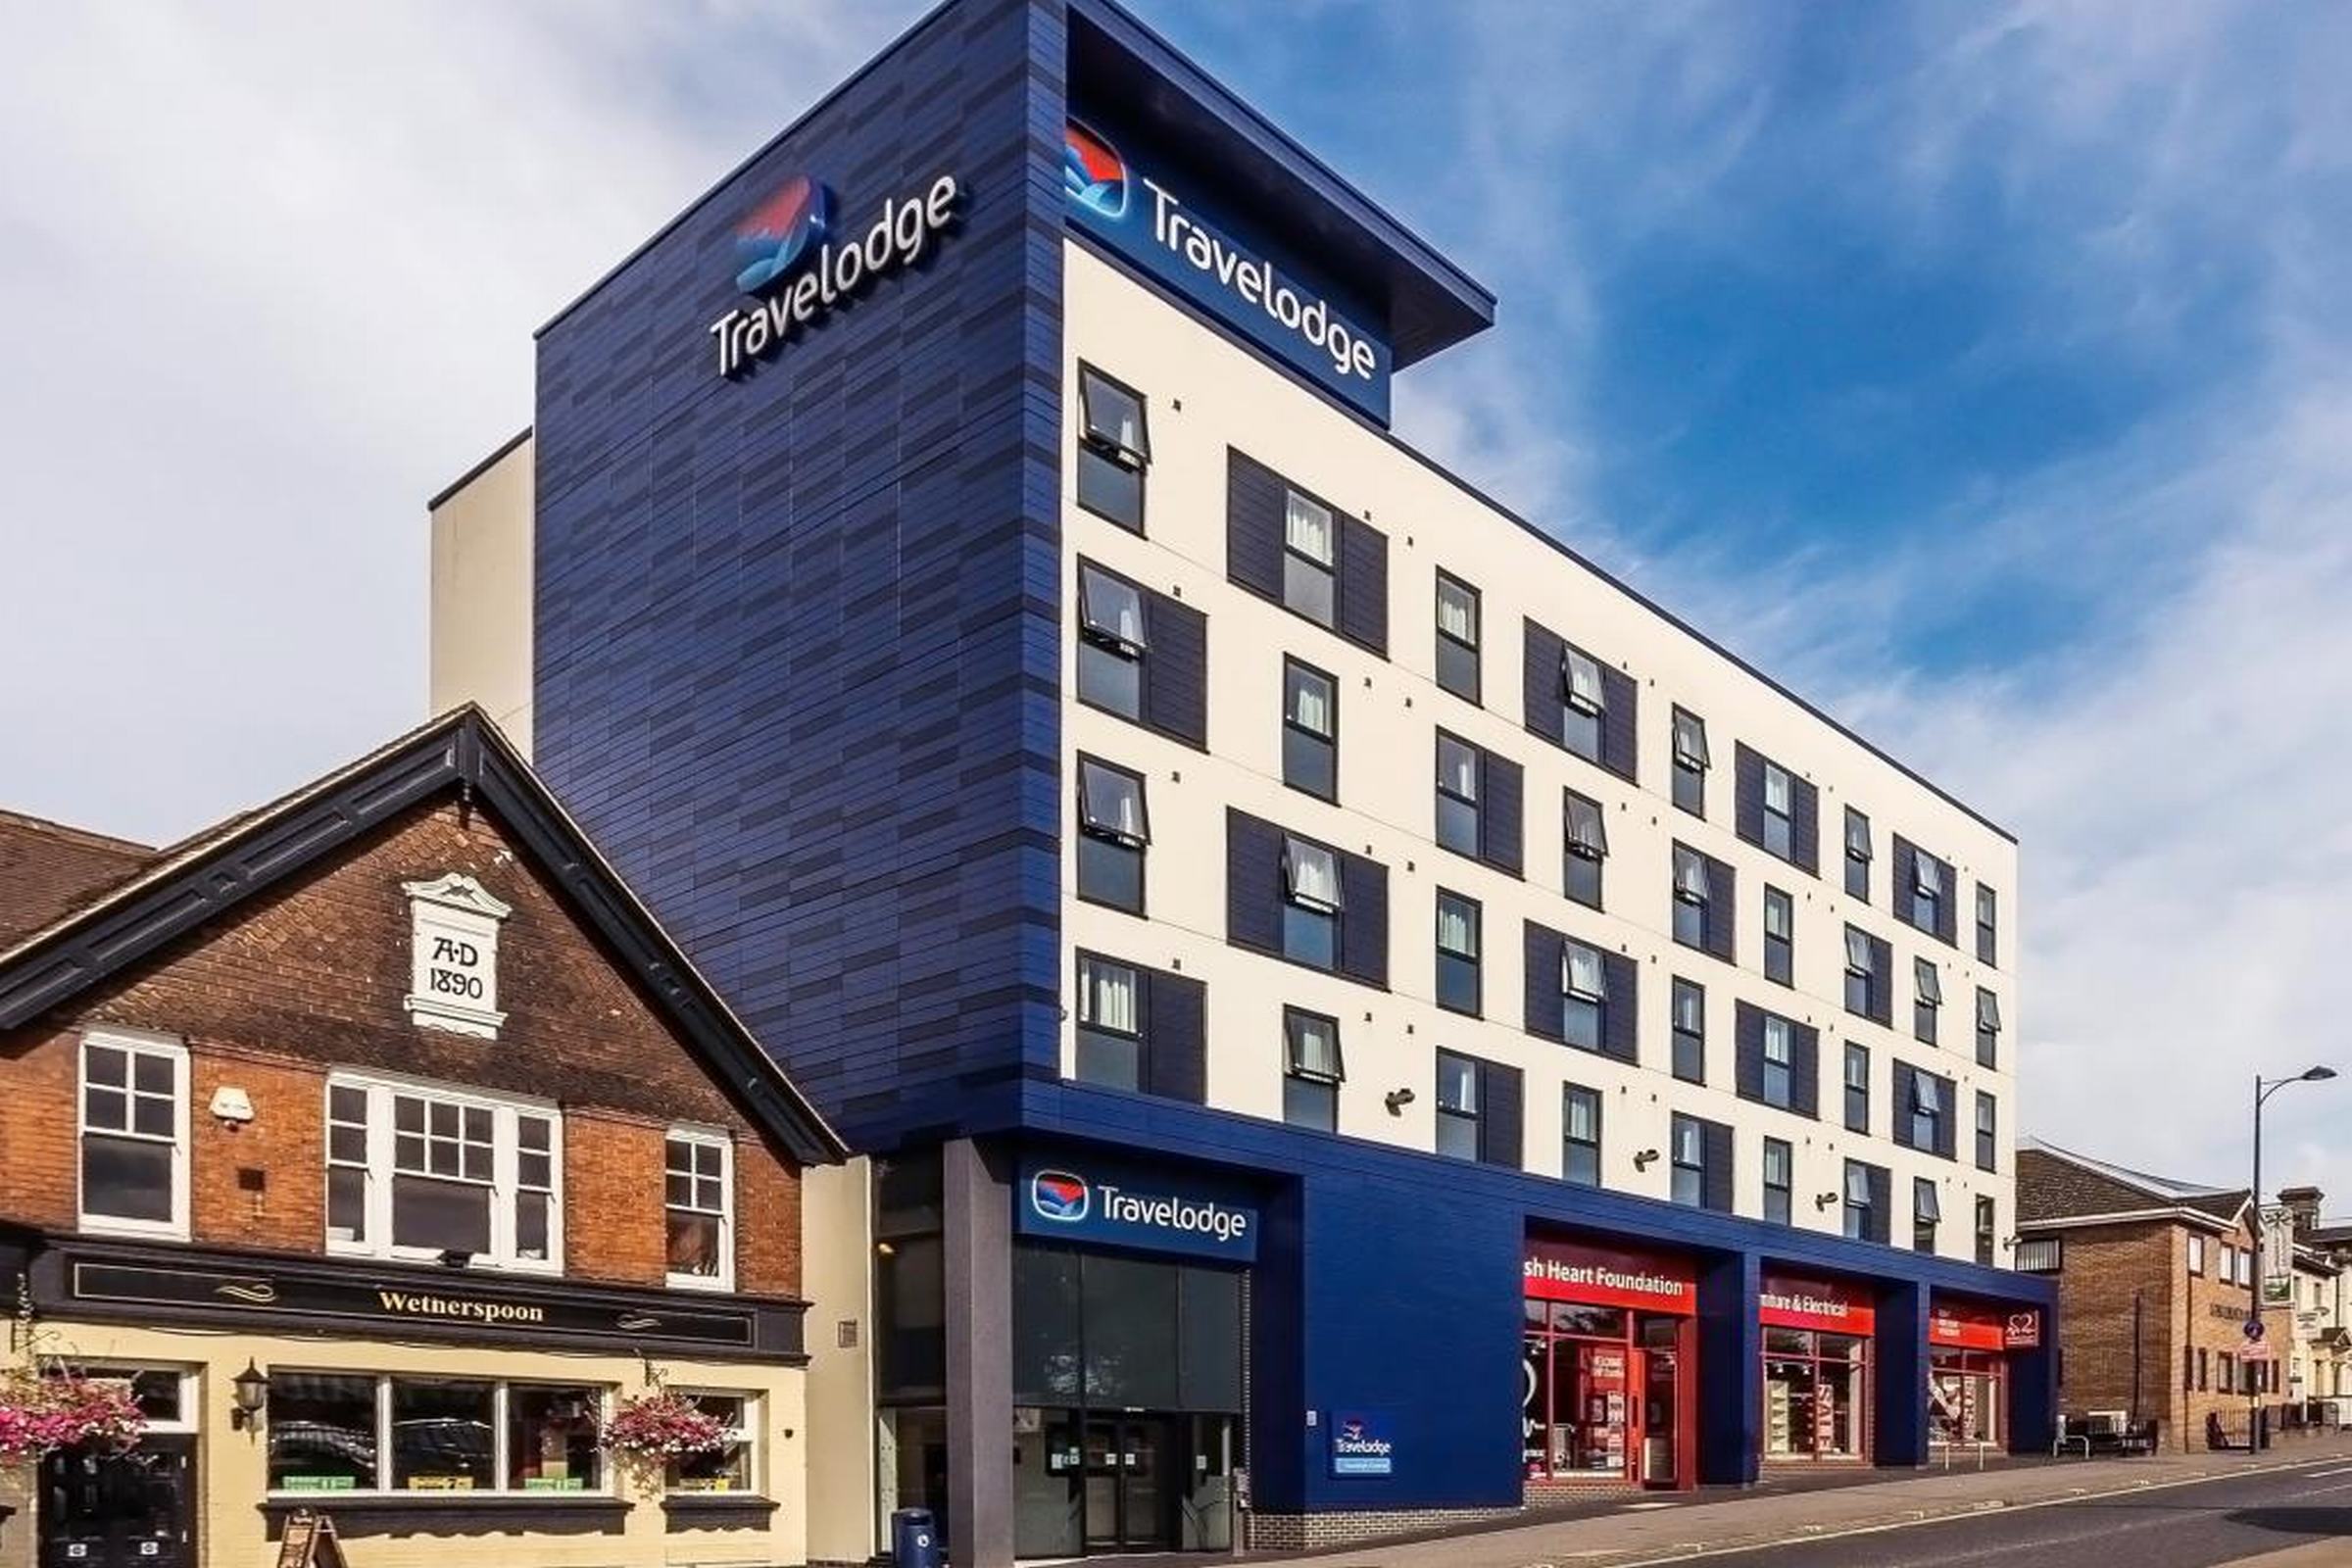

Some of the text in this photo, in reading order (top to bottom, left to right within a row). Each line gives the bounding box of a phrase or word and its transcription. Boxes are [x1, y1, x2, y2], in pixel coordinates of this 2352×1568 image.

[710, 175, 956, 376] Travelodge
[1143, 177, 1376, 380] Travelodge
[430, 967, 483, 1000] 1890
[1097, 1185, 1247, 1242] Travelodge
[1547, 1259, 1593, 1285] Heart
[1596, 1266, 1684, 1296] Foundation
[378, 1291, 544, 1322] Wetherspoon
[1791, 1294, 1801, 1312] &
[1803, 1296, 1848, 1318] Electrical
[1335, 1438, 1392, 1457] Travelodge
